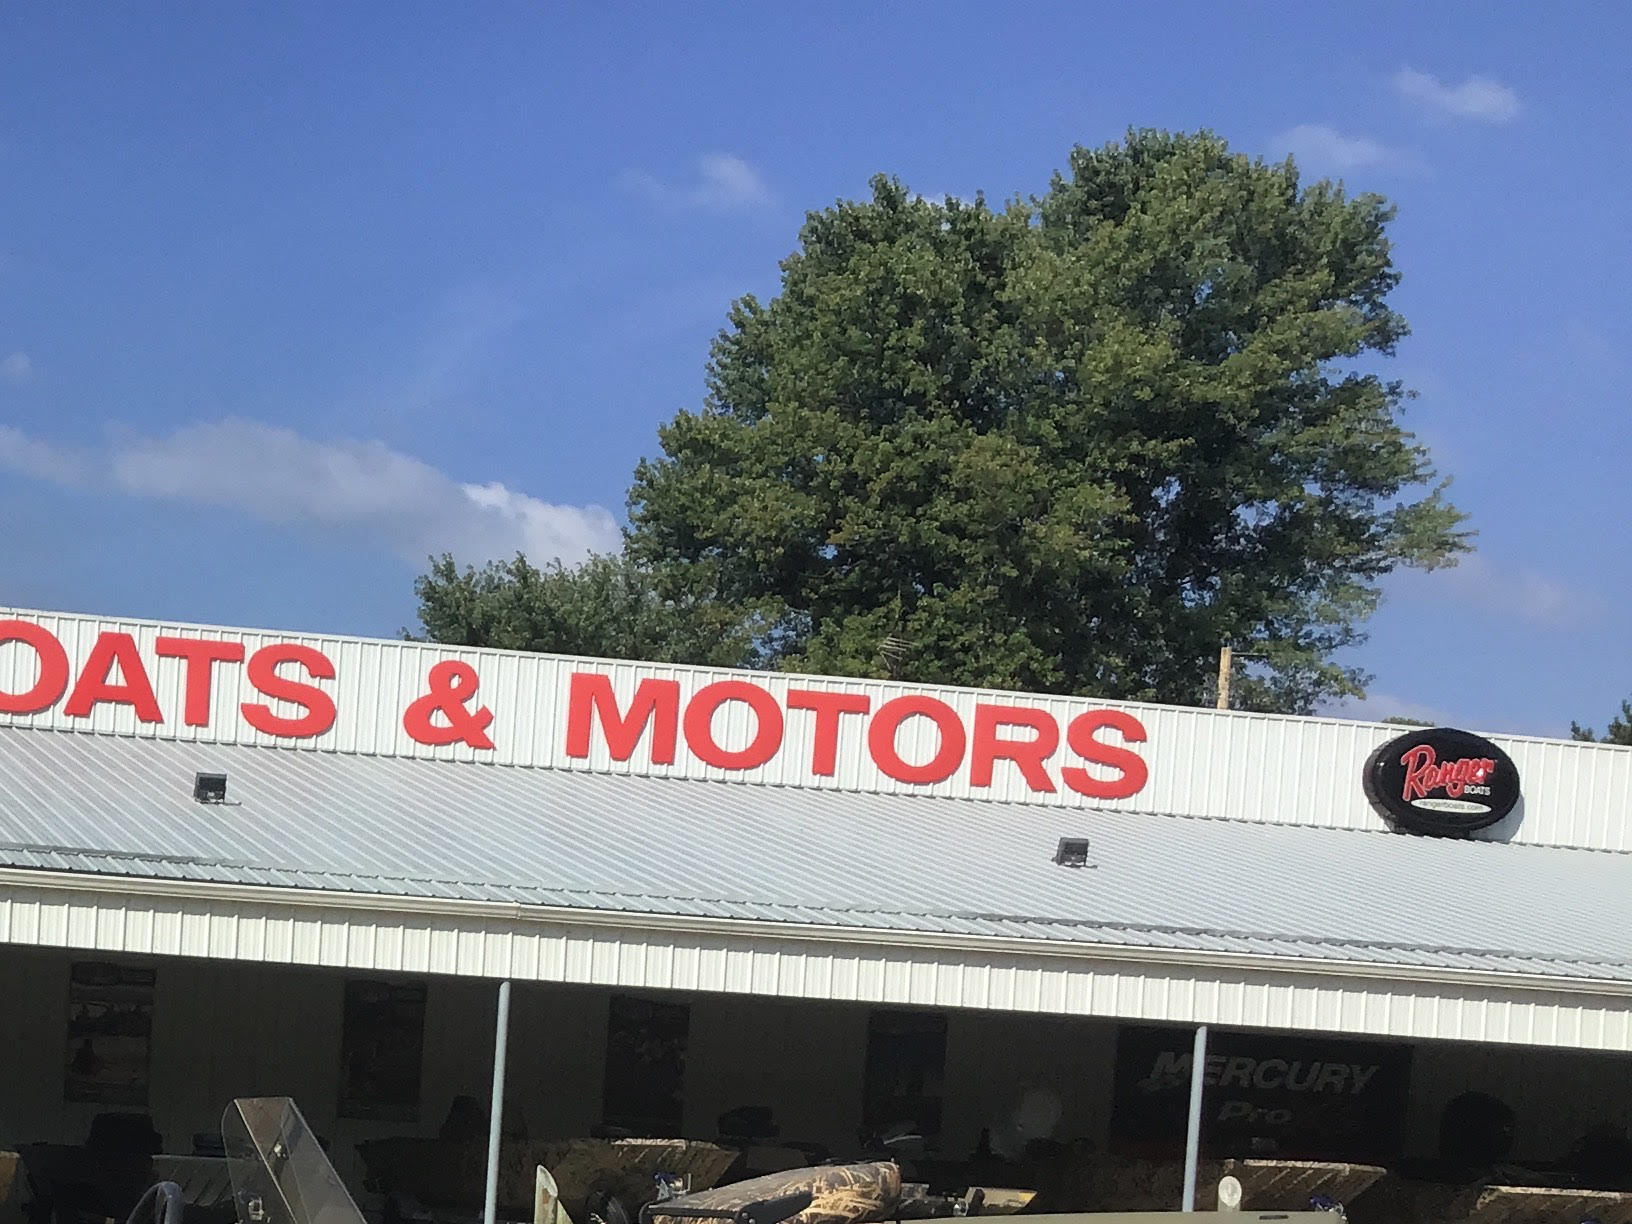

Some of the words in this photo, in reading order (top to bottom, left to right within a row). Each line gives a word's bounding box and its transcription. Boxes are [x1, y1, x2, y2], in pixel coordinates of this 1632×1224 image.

[402, 659, 497, 751] &
[565, 672, 1149, 800] MOTORS
[1400, 744, 1495, 802] Ranger
[1463, 784, 1491, 796] BOATS
